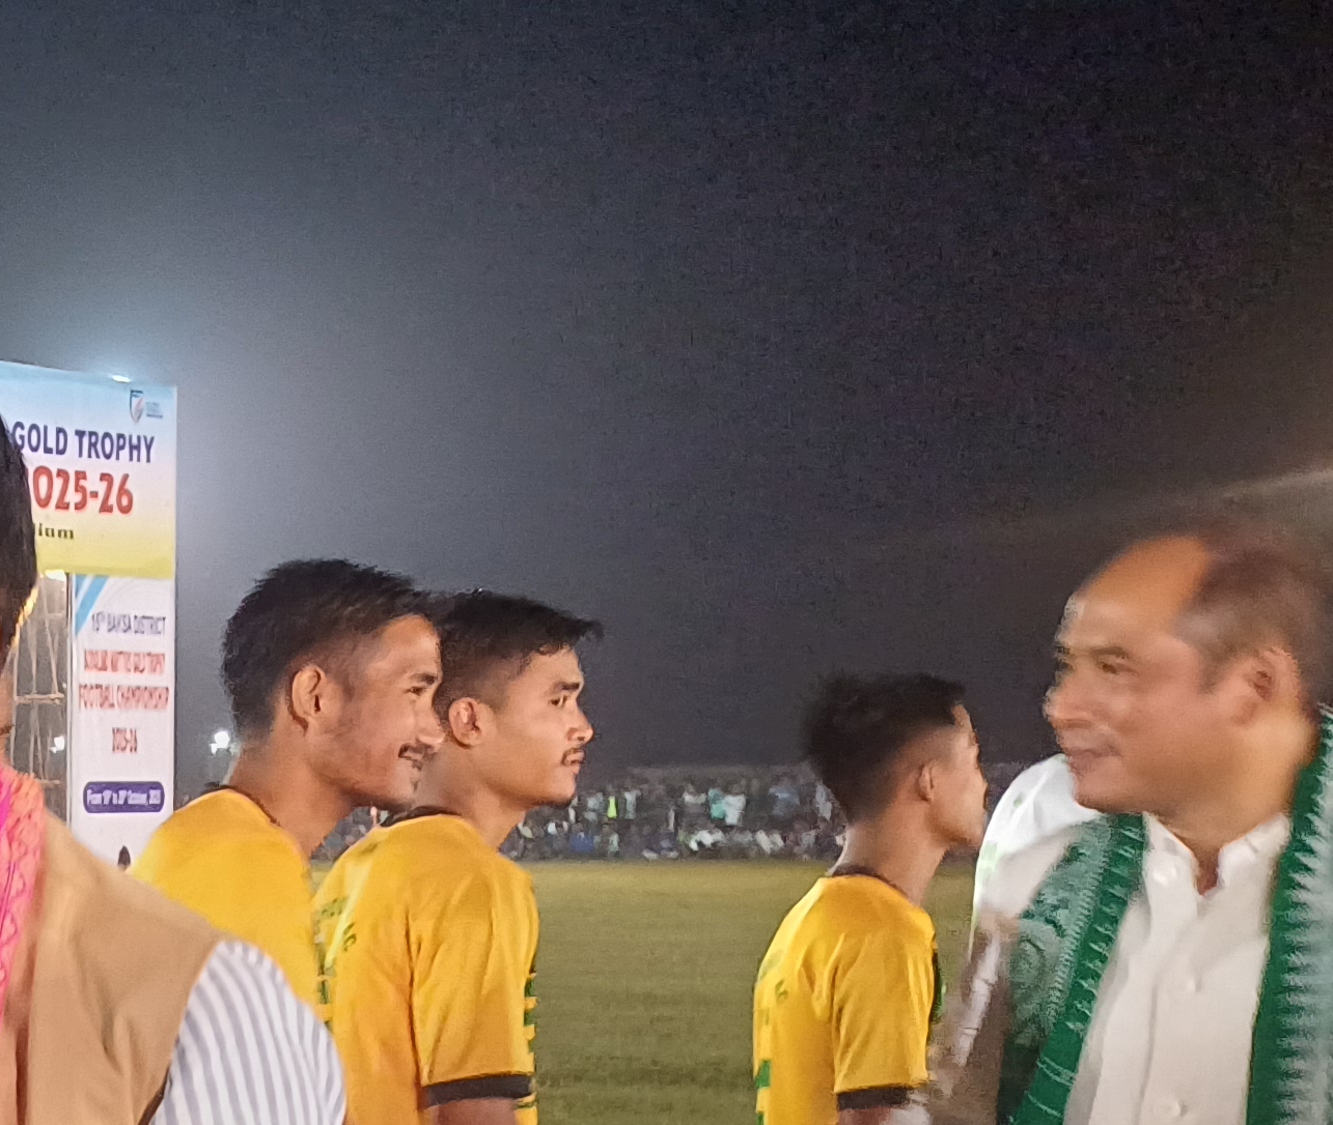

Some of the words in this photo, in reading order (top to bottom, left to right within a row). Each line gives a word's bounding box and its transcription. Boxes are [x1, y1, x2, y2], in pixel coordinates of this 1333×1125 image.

[12, 421, 68, 456] GOLD
[75, 429, 155, 463] TROPHY
[33, 465, 134, 515] 025-26
